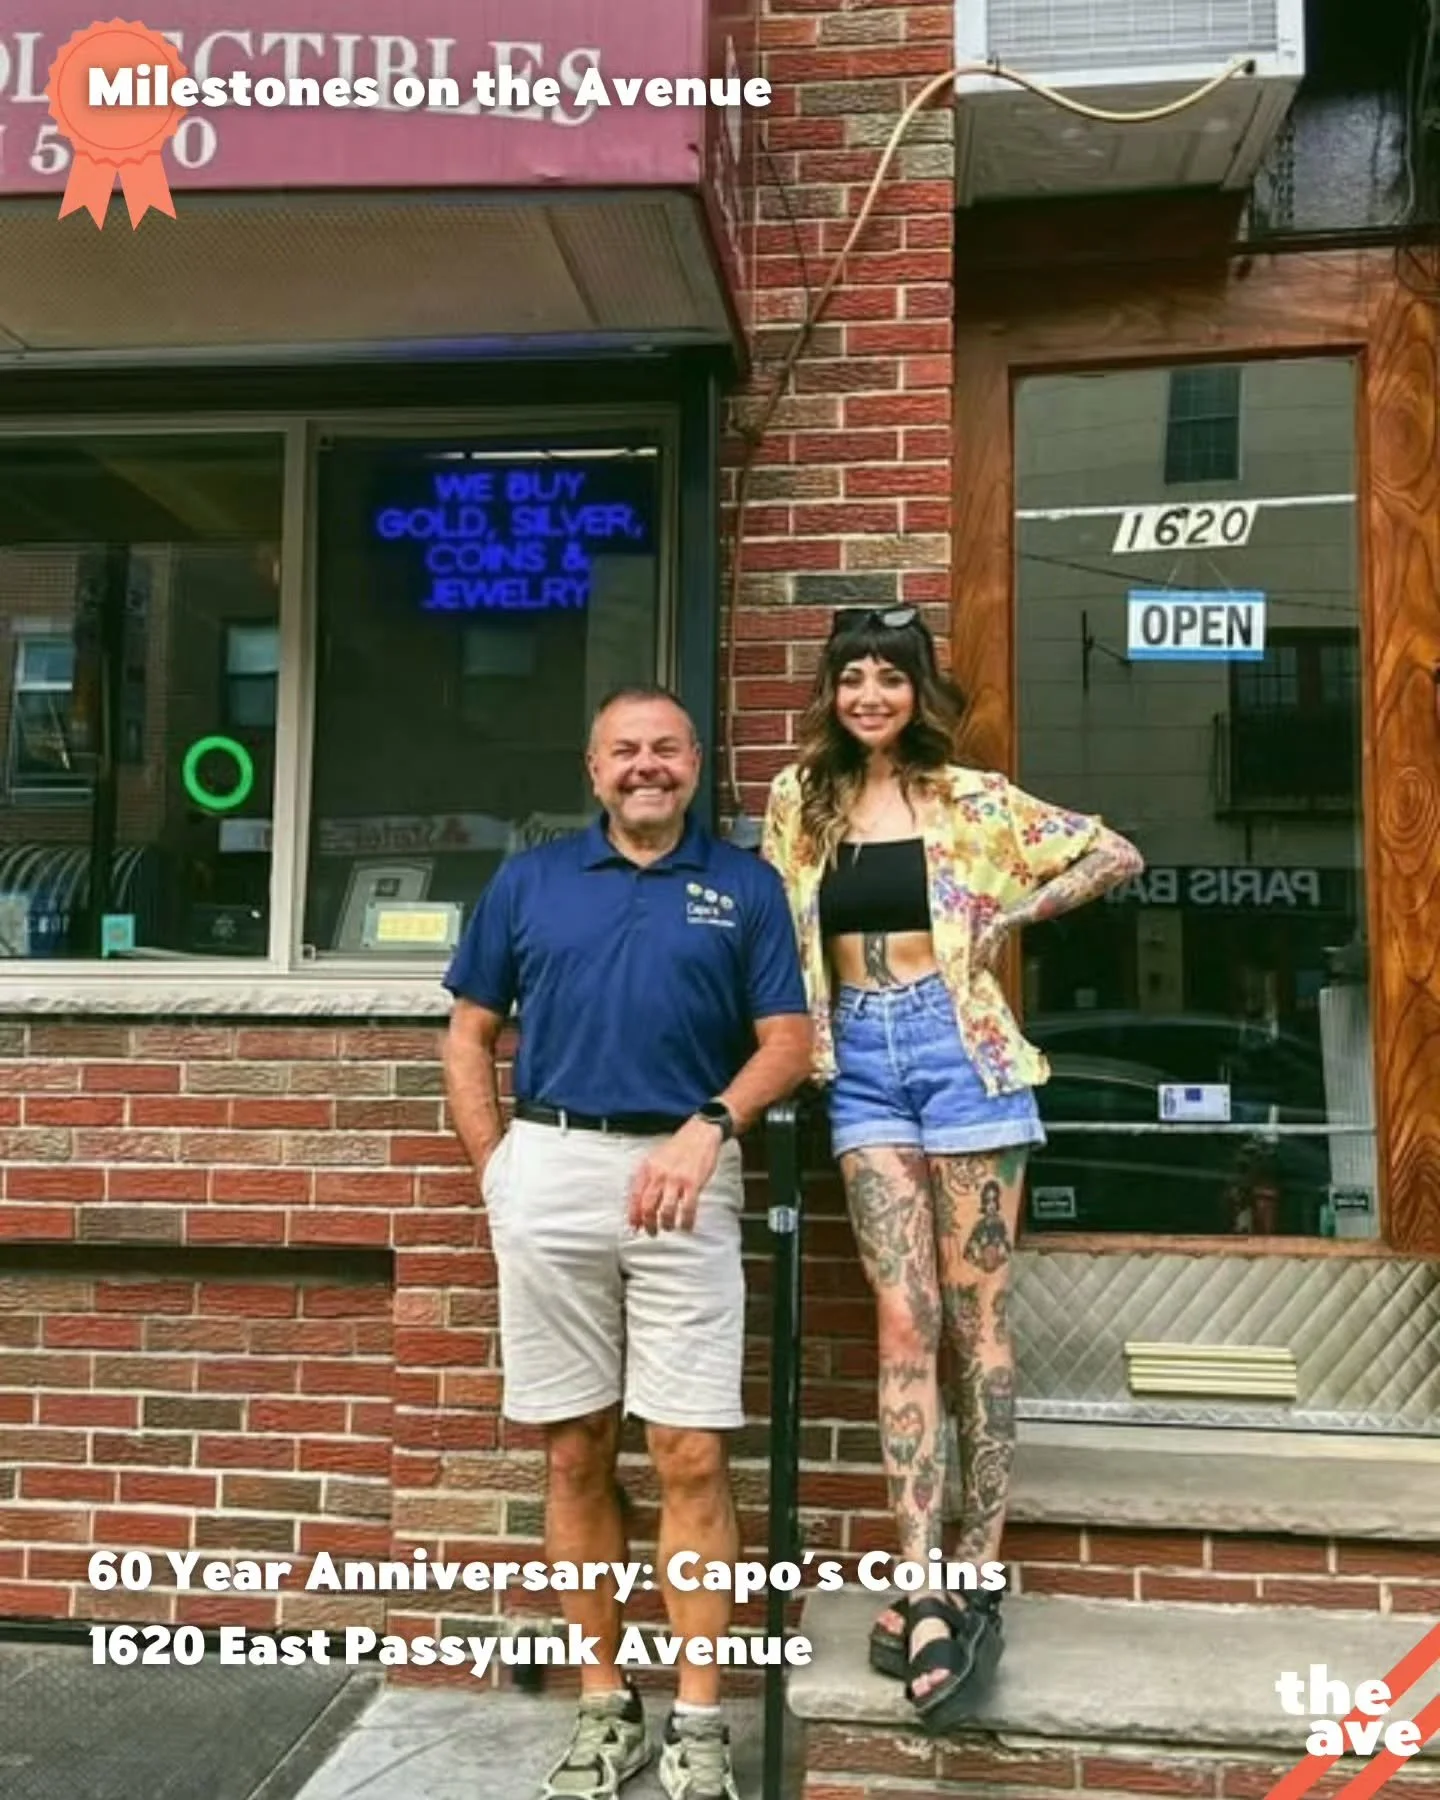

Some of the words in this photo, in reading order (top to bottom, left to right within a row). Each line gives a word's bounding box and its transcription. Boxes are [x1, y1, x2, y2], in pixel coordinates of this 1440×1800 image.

[434, 472, 494, 500] WE
[507, 471, 584, 500] BUY
[376, 508, 498, 540] GOLD,
[511, 504, 643, 539] SILVER,
[1127, 506, 1249, 549] 1620
[426, 543, 547, 572] COINS
[561, 543, 590, 572] &
[422, 577, 591, 608] JEWELRY
[1141, 605, 1253, 647] OPEN
